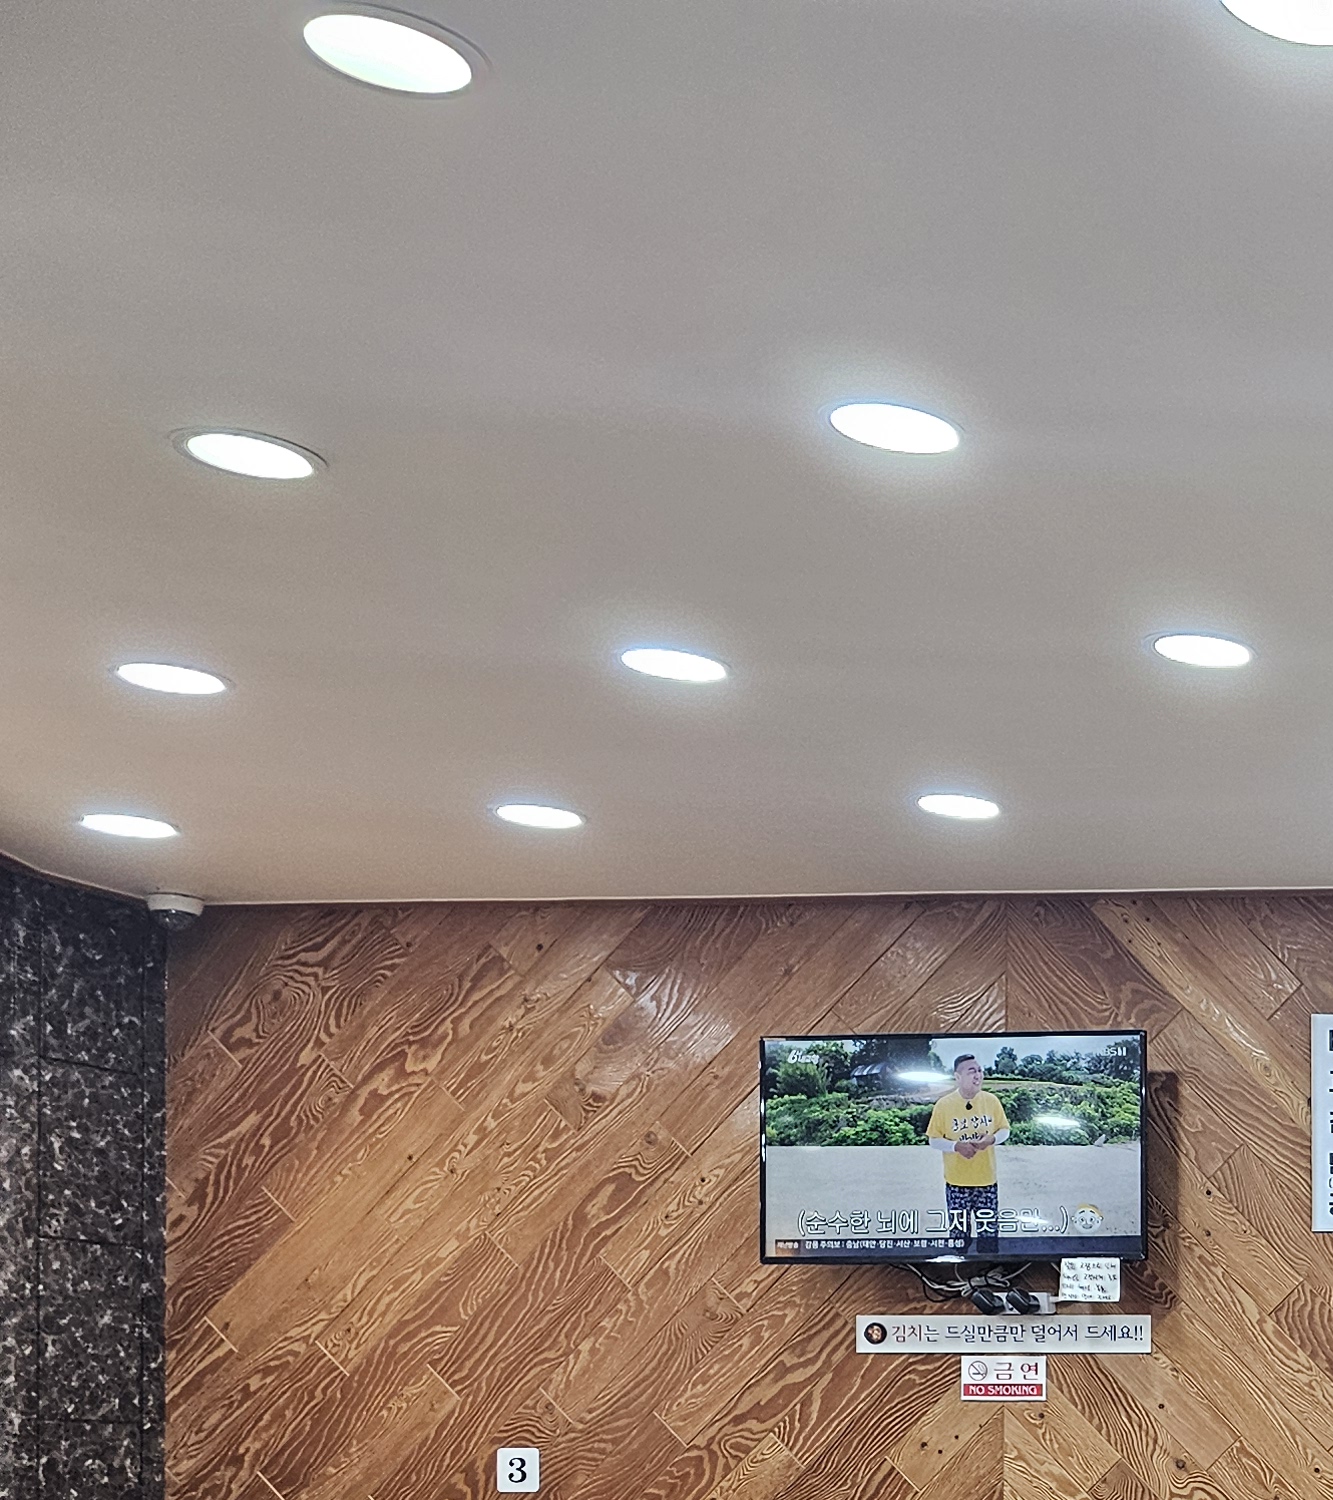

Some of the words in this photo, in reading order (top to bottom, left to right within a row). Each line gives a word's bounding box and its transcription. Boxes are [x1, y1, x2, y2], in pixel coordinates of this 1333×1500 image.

[797, 1209, 872, 1237] (순수한
[876, 1209, 919, 1234] 뇌에
[925, 1209, 968, 1234] 그저
[891, 1324, 940, 1343] 김치는
[944, 1324, 1027, 1343] 드실만큼만
[1031, 1323, 1079, 1342] 덜어서
[1084, 1323, 1145, 1342] 드세요!!
[968, 1385, 985, 1396] NO
[987, 1385, 1038, 1396] SMOKING
[508, 1457, 527, 1484] 3
